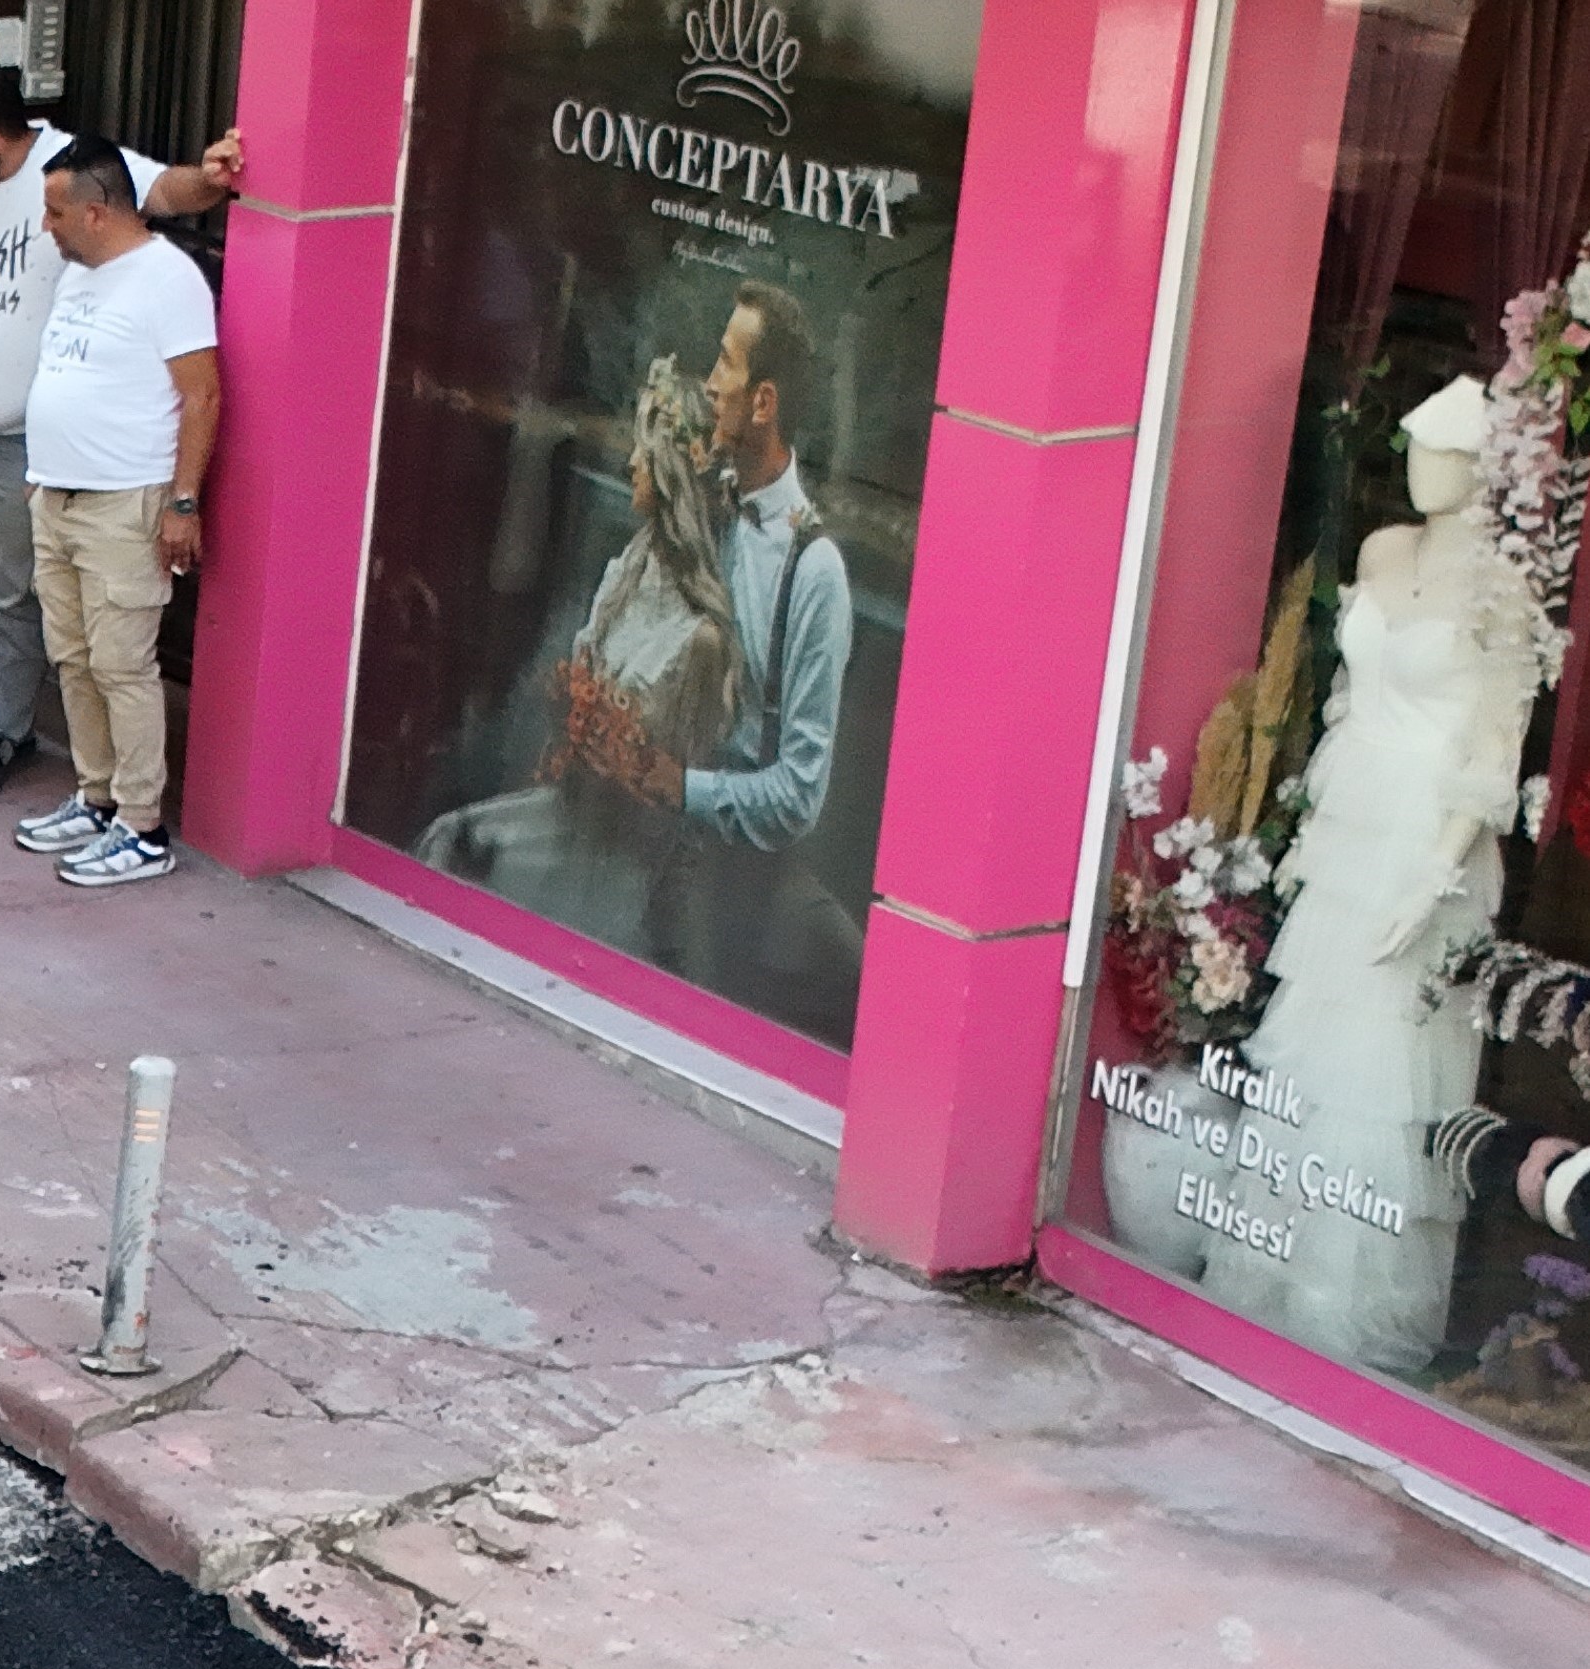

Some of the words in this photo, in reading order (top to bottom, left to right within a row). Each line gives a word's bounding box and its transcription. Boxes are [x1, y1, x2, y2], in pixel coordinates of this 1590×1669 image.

[552, 99, 894, 239] CONCEPTARYA
[651, 198, 710, 227] custom
[1199, 1044, 1302, 1127] Kiralık
[1091, 1059, 1183, 1138] Nikah
[1192, 1115, 1229, 1155] ve
[1237, 1125, 1289, 1194] Dış
[1298, 1153, 1404, 1236] Çekim
[1175, 1172, 1296, 1261] Elbisesi
